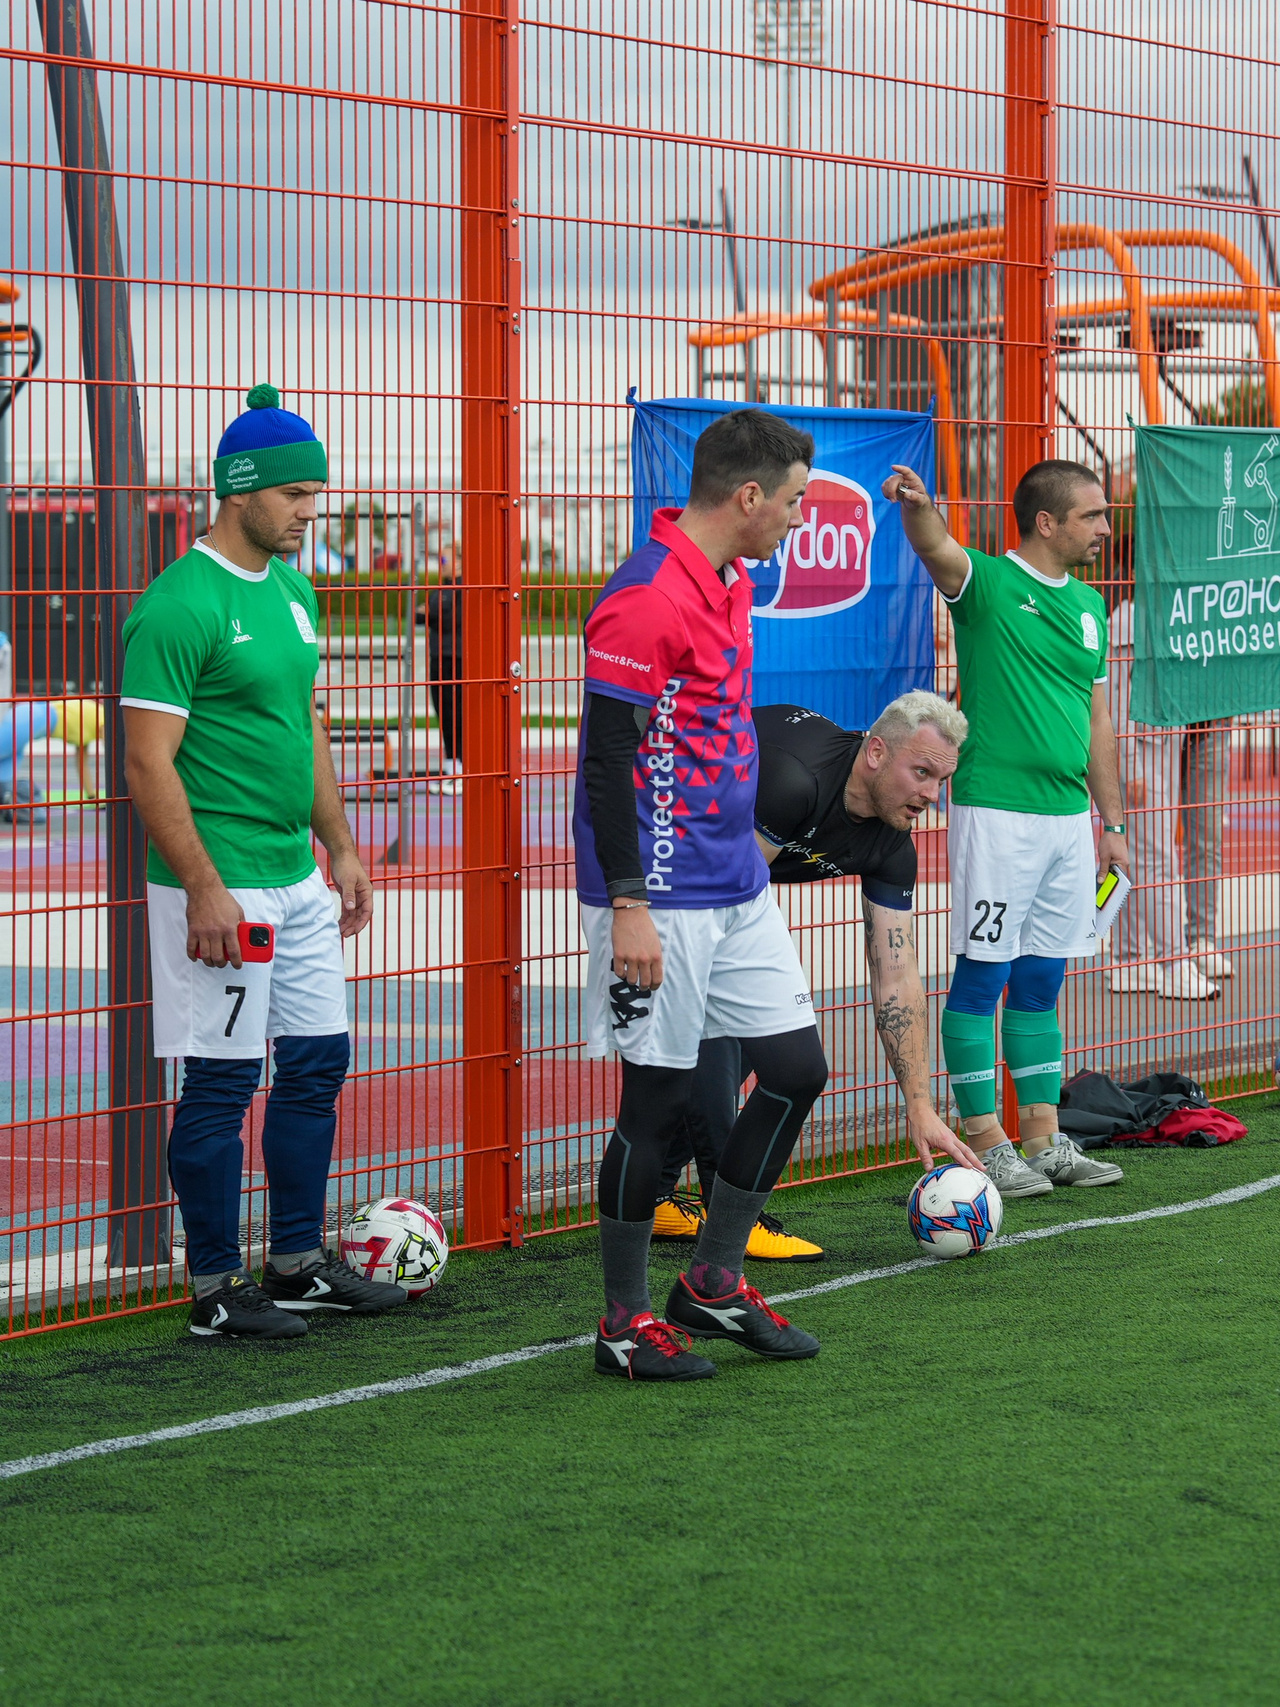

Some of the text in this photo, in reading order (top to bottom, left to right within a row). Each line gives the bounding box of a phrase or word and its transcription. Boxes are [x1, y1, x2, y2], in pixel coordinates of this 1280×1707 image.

[589, 646, 652, 673] Protect&Feed
[969, 899, 1007, 943] 23
[225, 985, 246, 1037] 7
